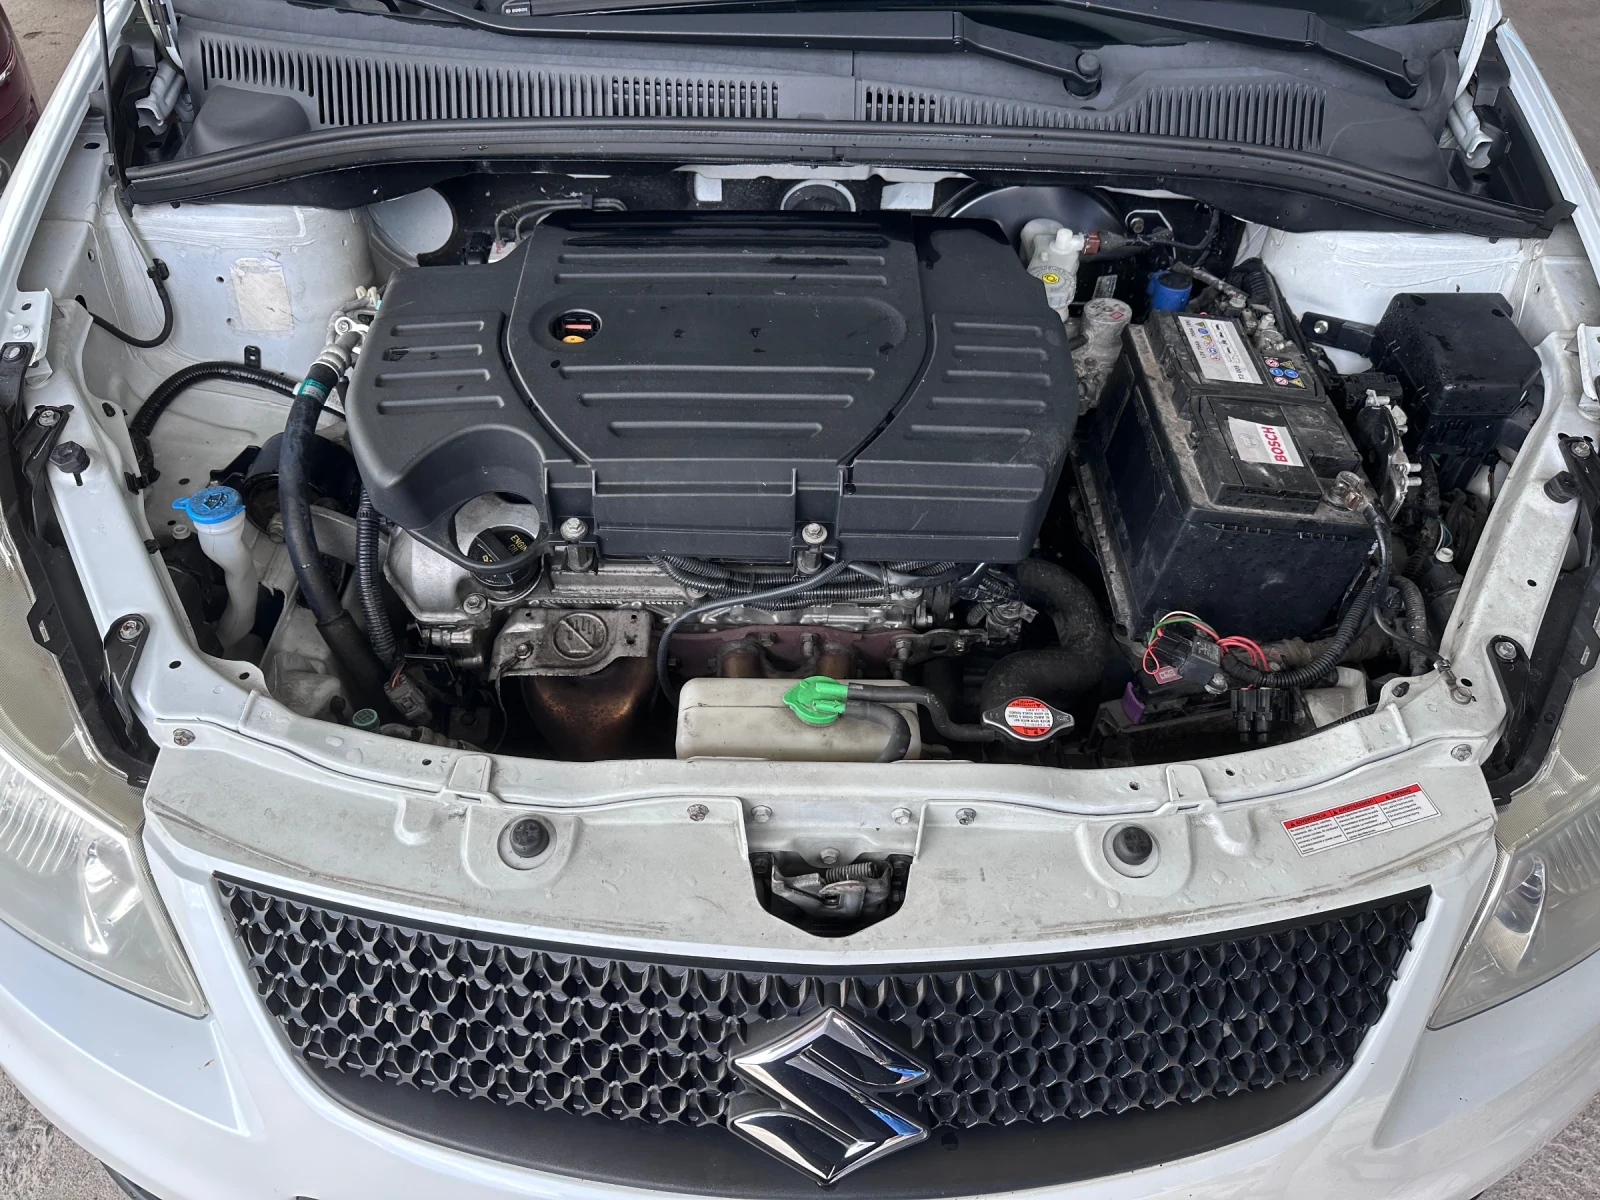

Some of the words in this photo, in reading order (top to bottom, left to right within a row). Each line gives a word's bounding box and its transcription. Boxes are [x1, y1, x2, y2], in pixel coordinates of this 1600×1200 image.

[1261, 426, 1288, 463] BOSCH
[508, 543, 519, 556] OIL
[1295, 812, 1327, 825] ADVERTENCIA
